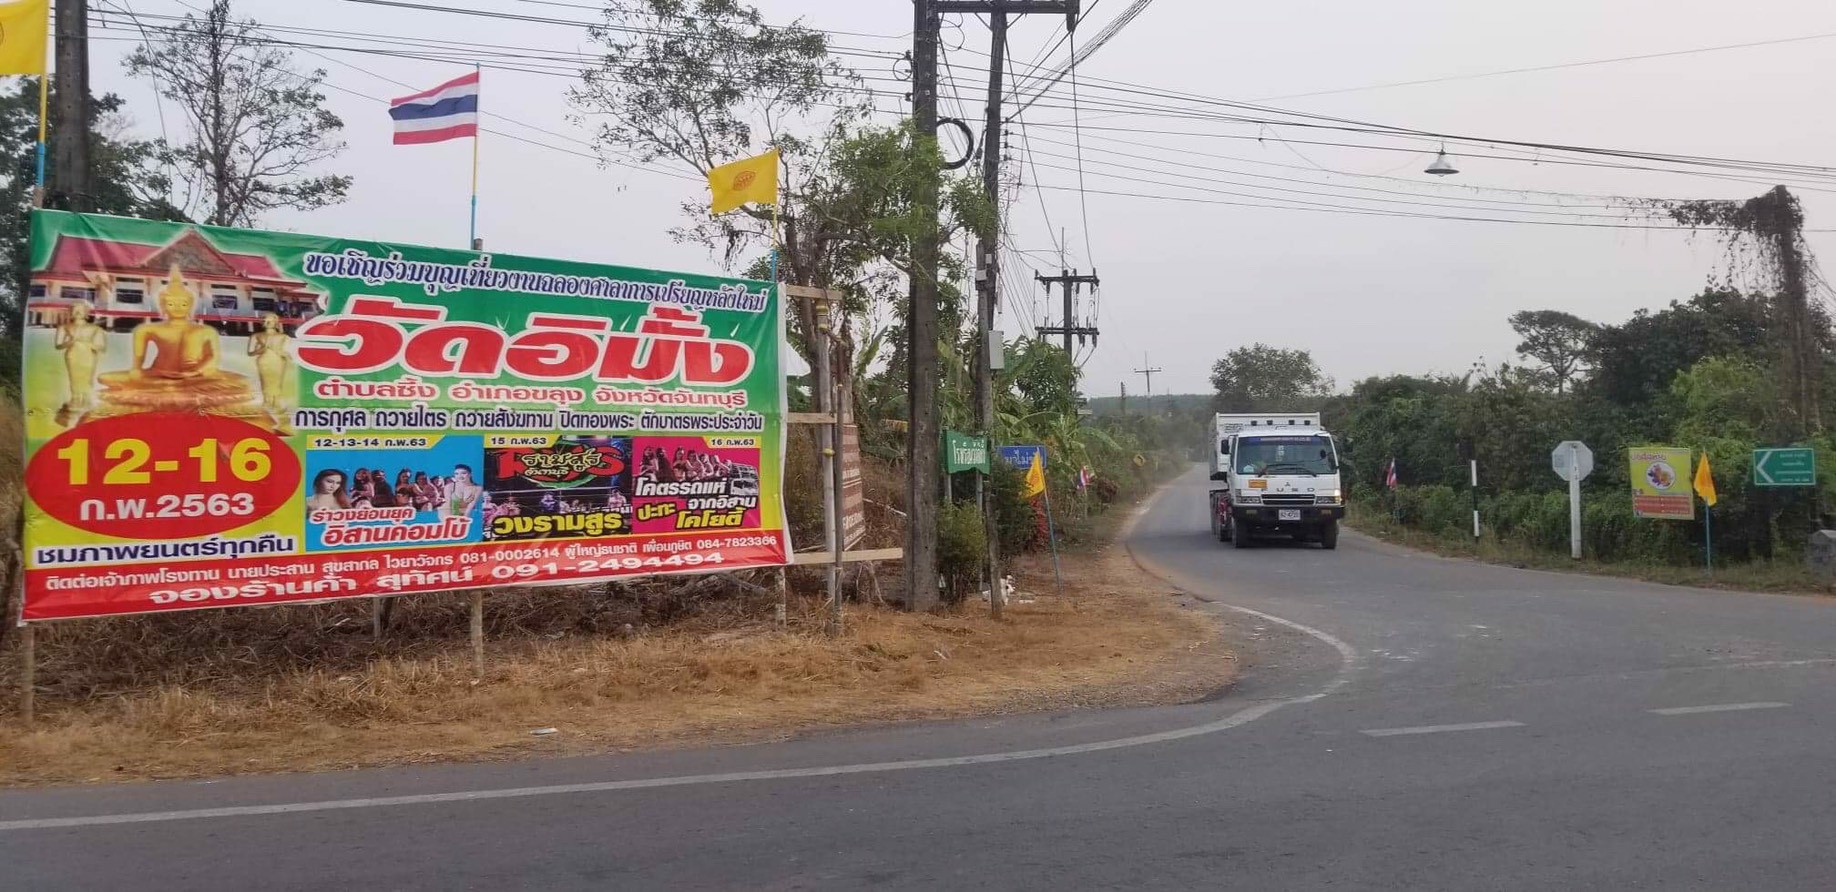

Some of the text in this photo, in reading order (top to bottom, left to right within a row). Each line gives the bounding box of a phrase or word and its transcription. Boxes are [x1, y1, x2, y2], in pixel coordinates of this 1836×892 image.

[306, 251, 767, 311] ขอเชิญร่วมบุญเที่ยวงานฉลองศาลาการเปรียญหลังใหม่
[297, 299, 750, 382] วัดอิมั้ง
[452, 383, 582, 407] อำเภอขลุง
[596, 386, 746, 409] จังหวัดจันทบุรี
[295, 405, 762, 431] การกุศล ถวายไตร ถวายสังฆทาน ปิดทองพระ ตักบาตรพระประจำวัน
[315, 438, 426, 447] 12-13-14 ก.พ.63
[57, 437, 272, 485] 12-16
[80, 494, 254, 520] ก.พ.2563
[312, 507, 414, 523] รำวงย้อนยุค
[638, 502, 675, 521] ปะทะ
[494, 513, 623, 535] วงรามสูร
[38, 534, 293, 564] ชมภาพยนตร์ทุกคืน
[46, 568, 220, 590] ติดต่อเจ้าภาพโรงทาน
[228, 563, 314, 579] นายประสาน
[322, 558, 379, 574] สุขสากล
[384, 554, 453, 568] ไวยาวัจกร
[460, 547, 560, 563] 081-0002614
[697, 535, 777, 550] 084-7823366
[149, 551, 725, 604] จองร้านค้า สุทัศน์ 091-2494494
